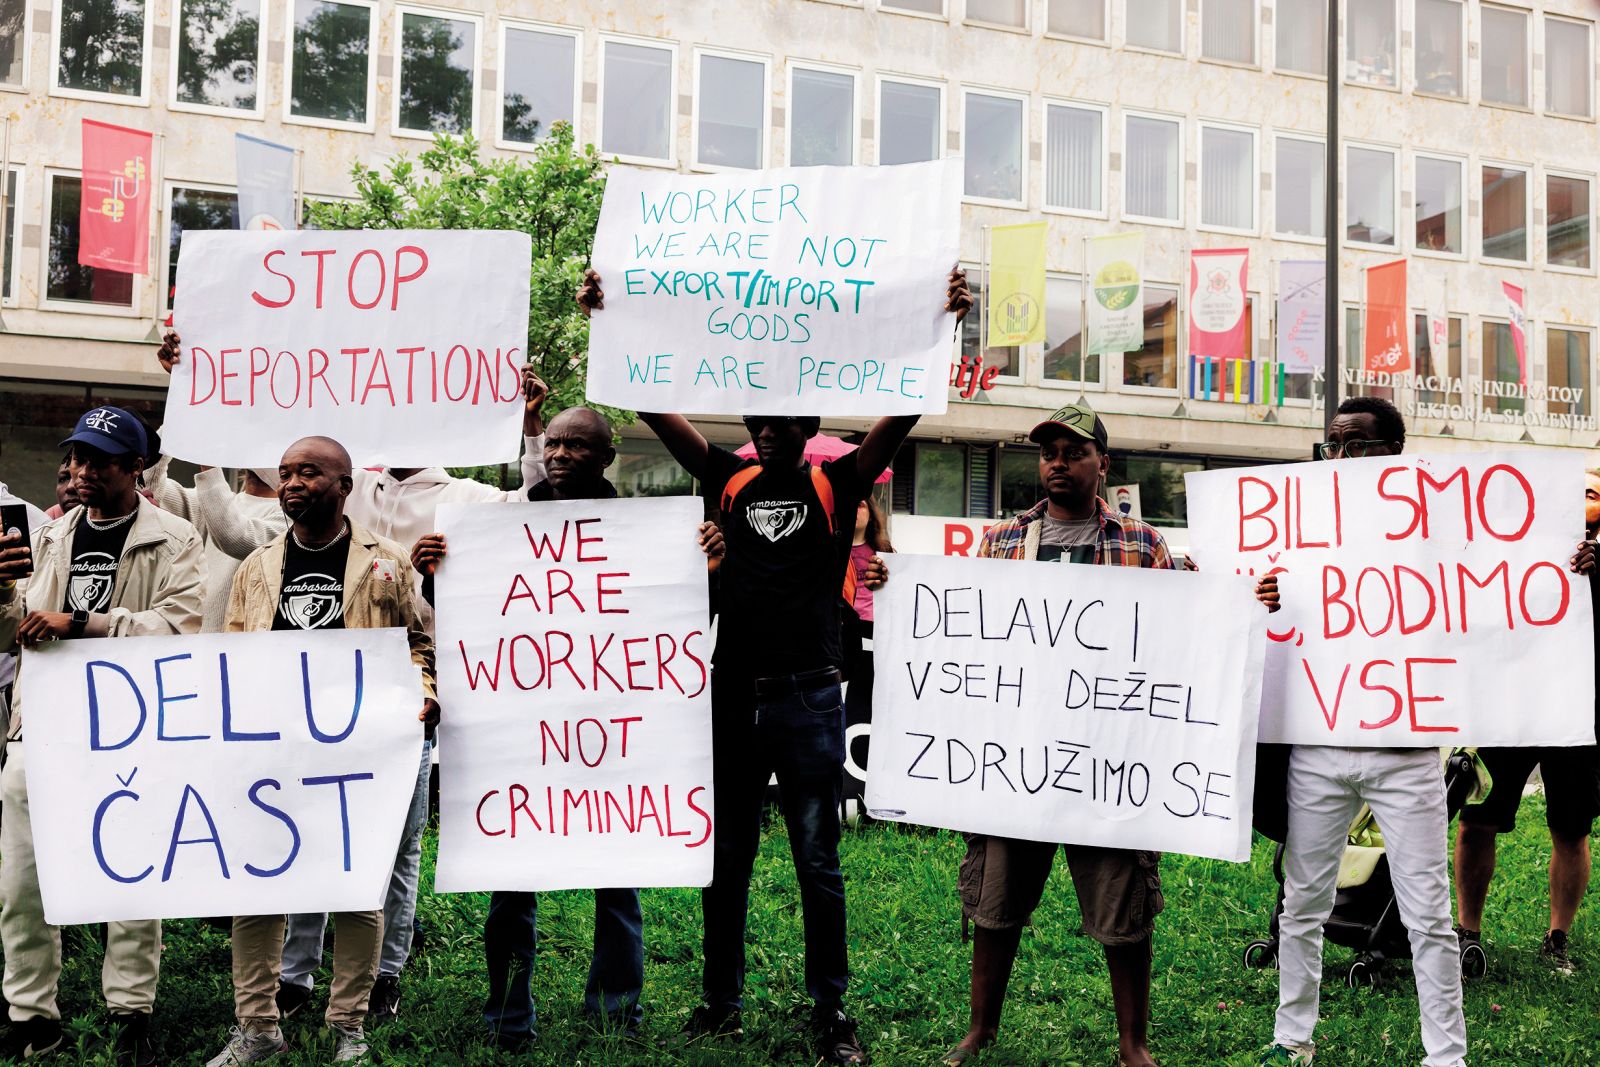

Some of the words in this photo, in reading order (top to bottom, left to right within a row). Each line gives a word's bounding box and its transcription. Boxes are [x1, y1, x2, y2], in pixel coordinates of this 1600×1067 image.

[641, 184, 808, 225] WORKER
[251, 245, 429, 311] STOP
[634, 232, 686, 260] WE
[696, 232, 770, 260] ARE
[798, 236, 888, 268] NOT
[625, 269, 875, 314] EXPORT/IMPORT
[707, 306, 812, 344] GOODS
[188, 344, 521, 410] DEPORTATIONS
[626, 354, 674, 384] WE
[694, 356, 768, 390] ARE
[798, 356, 925, 399] PEOPLE.
[950, 355, 1000, 399] ije
[1312, 365, 1464, 396] KNFEDERACIJA
[1473, 379, 1584, 404] SINDIKATOV
[1406, 400, 1493, 424] SEKTORJA
[1237, 470, 1342, 553] BILI
[1377, 463, 1536, 543] SMO
[524, 518, 608, 563] WE
[283, 580, 343, 593] ambasada
[501, 569, 630, 616] ARE
[1322, 560, 1571, 640] BODIMO
[912, 583, 1139, 662] DELAVCI
[458, 630, 706, 699] WORKERS
[906, 661, 1023, 708] VSEH
[1065, 671, 1219, 726] DEŽEL
[86, 648, 364, 751] DELU
[1302, 657, 1460, 733] VSE
[540, 716, 643, 768] NOT
[905, 732, 1151, 808] ZDRUŽIMO
[1163, 762, 1232, 820] SE
[92, 767, 374, 884] ČAST
[476, 784, 712, 848] CRIMINALS
